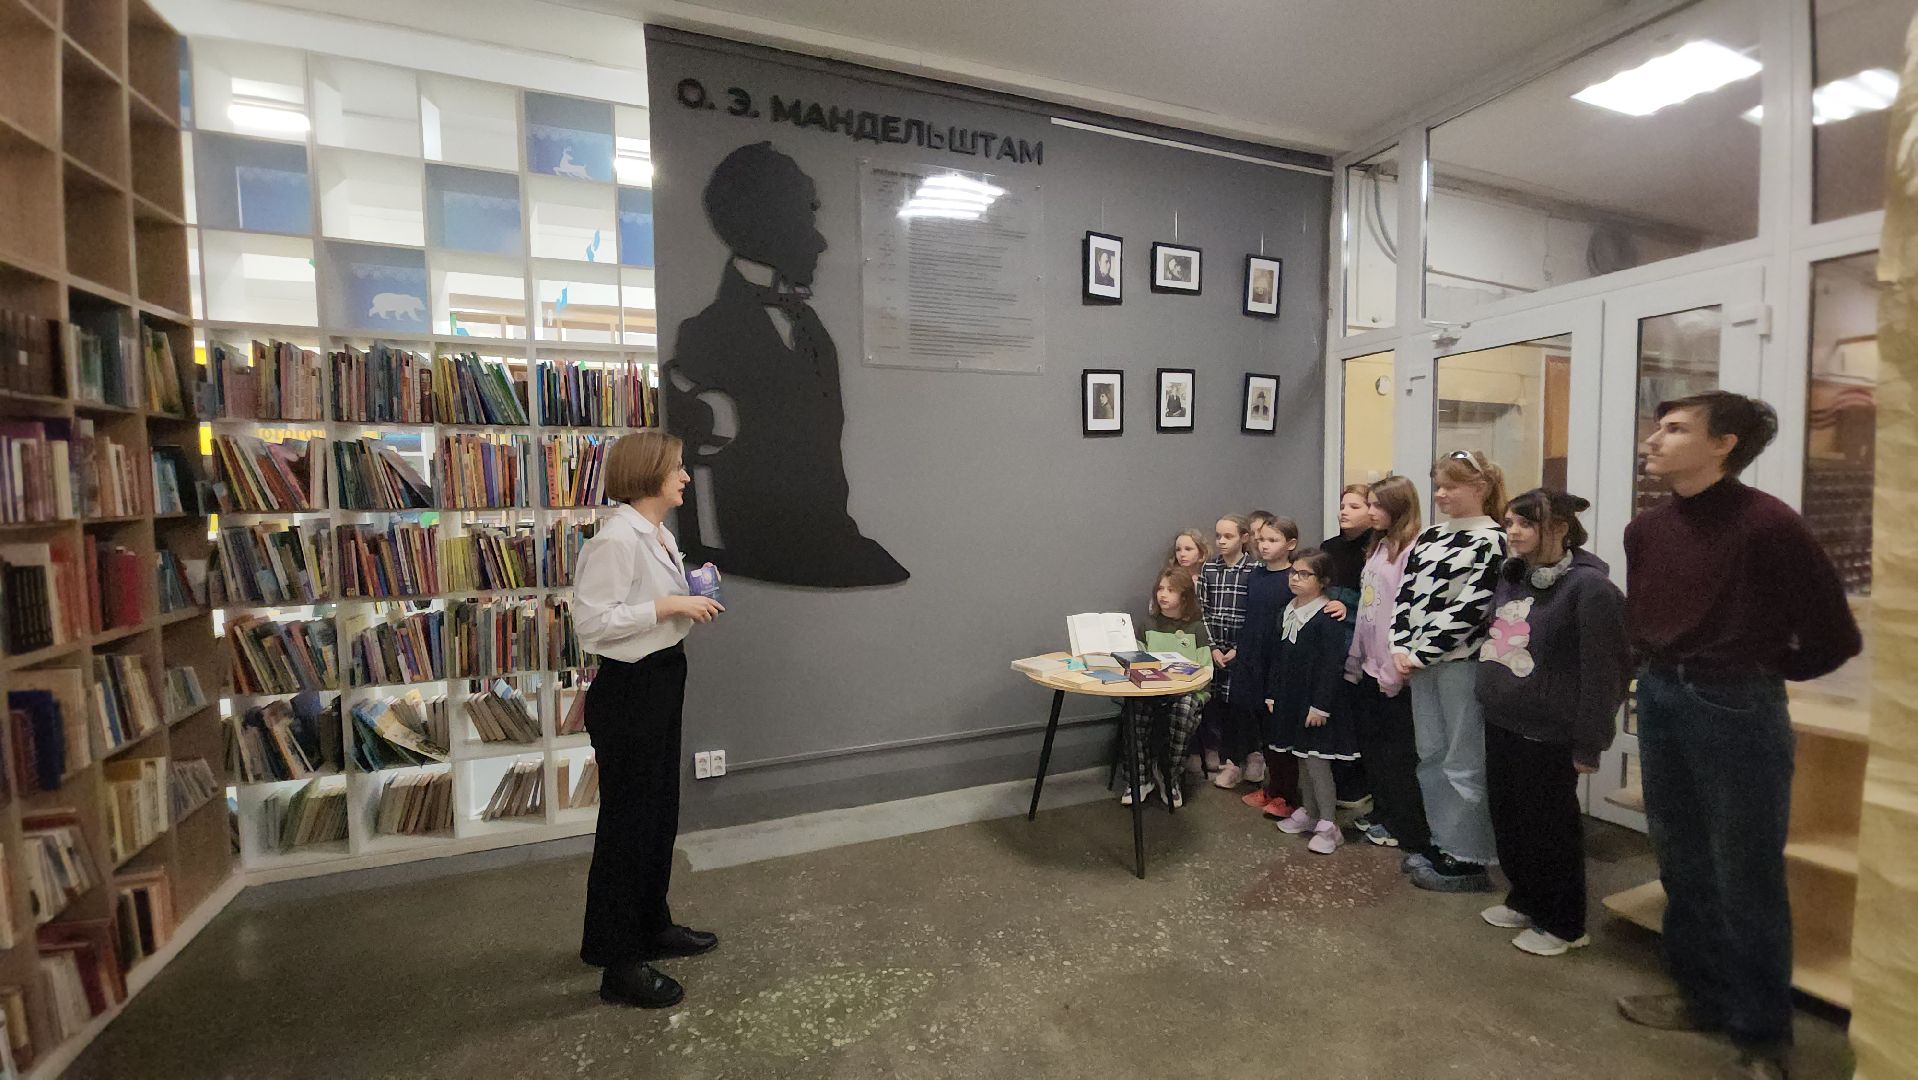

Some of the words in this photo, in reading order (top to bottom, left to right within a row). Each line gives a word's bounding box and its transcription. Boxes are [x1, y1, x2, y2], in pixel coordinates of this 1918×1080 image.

[676, 78, 717, 110] О.
[727, 86, 760, 119] Э.
[769, 94, 1044, 166] МАНДЕЛЬШТАМ
